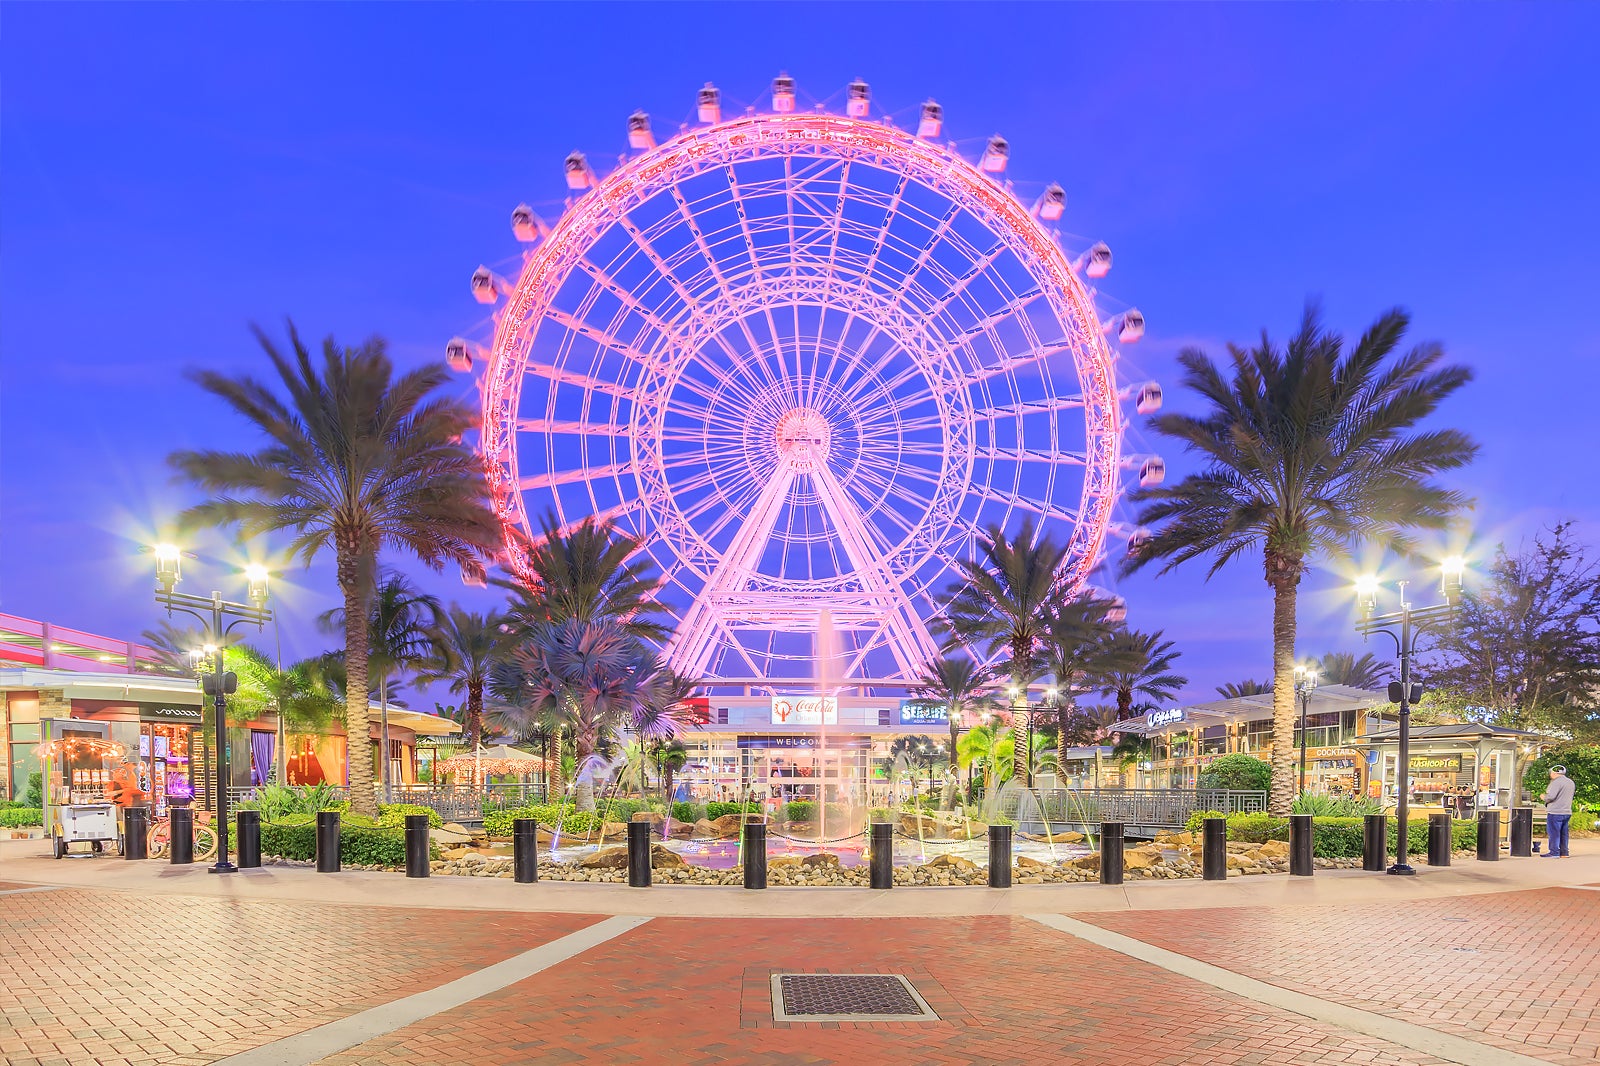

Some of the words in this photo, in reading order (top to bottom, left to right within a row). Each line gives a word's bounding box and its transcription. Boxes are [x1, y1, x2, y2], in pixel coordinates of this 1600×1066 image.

[902, 704, 924, 719] SEA
[925, 705, 947, 719] LIFE
[1316, 748, 1356, 757] COCKTAILS
